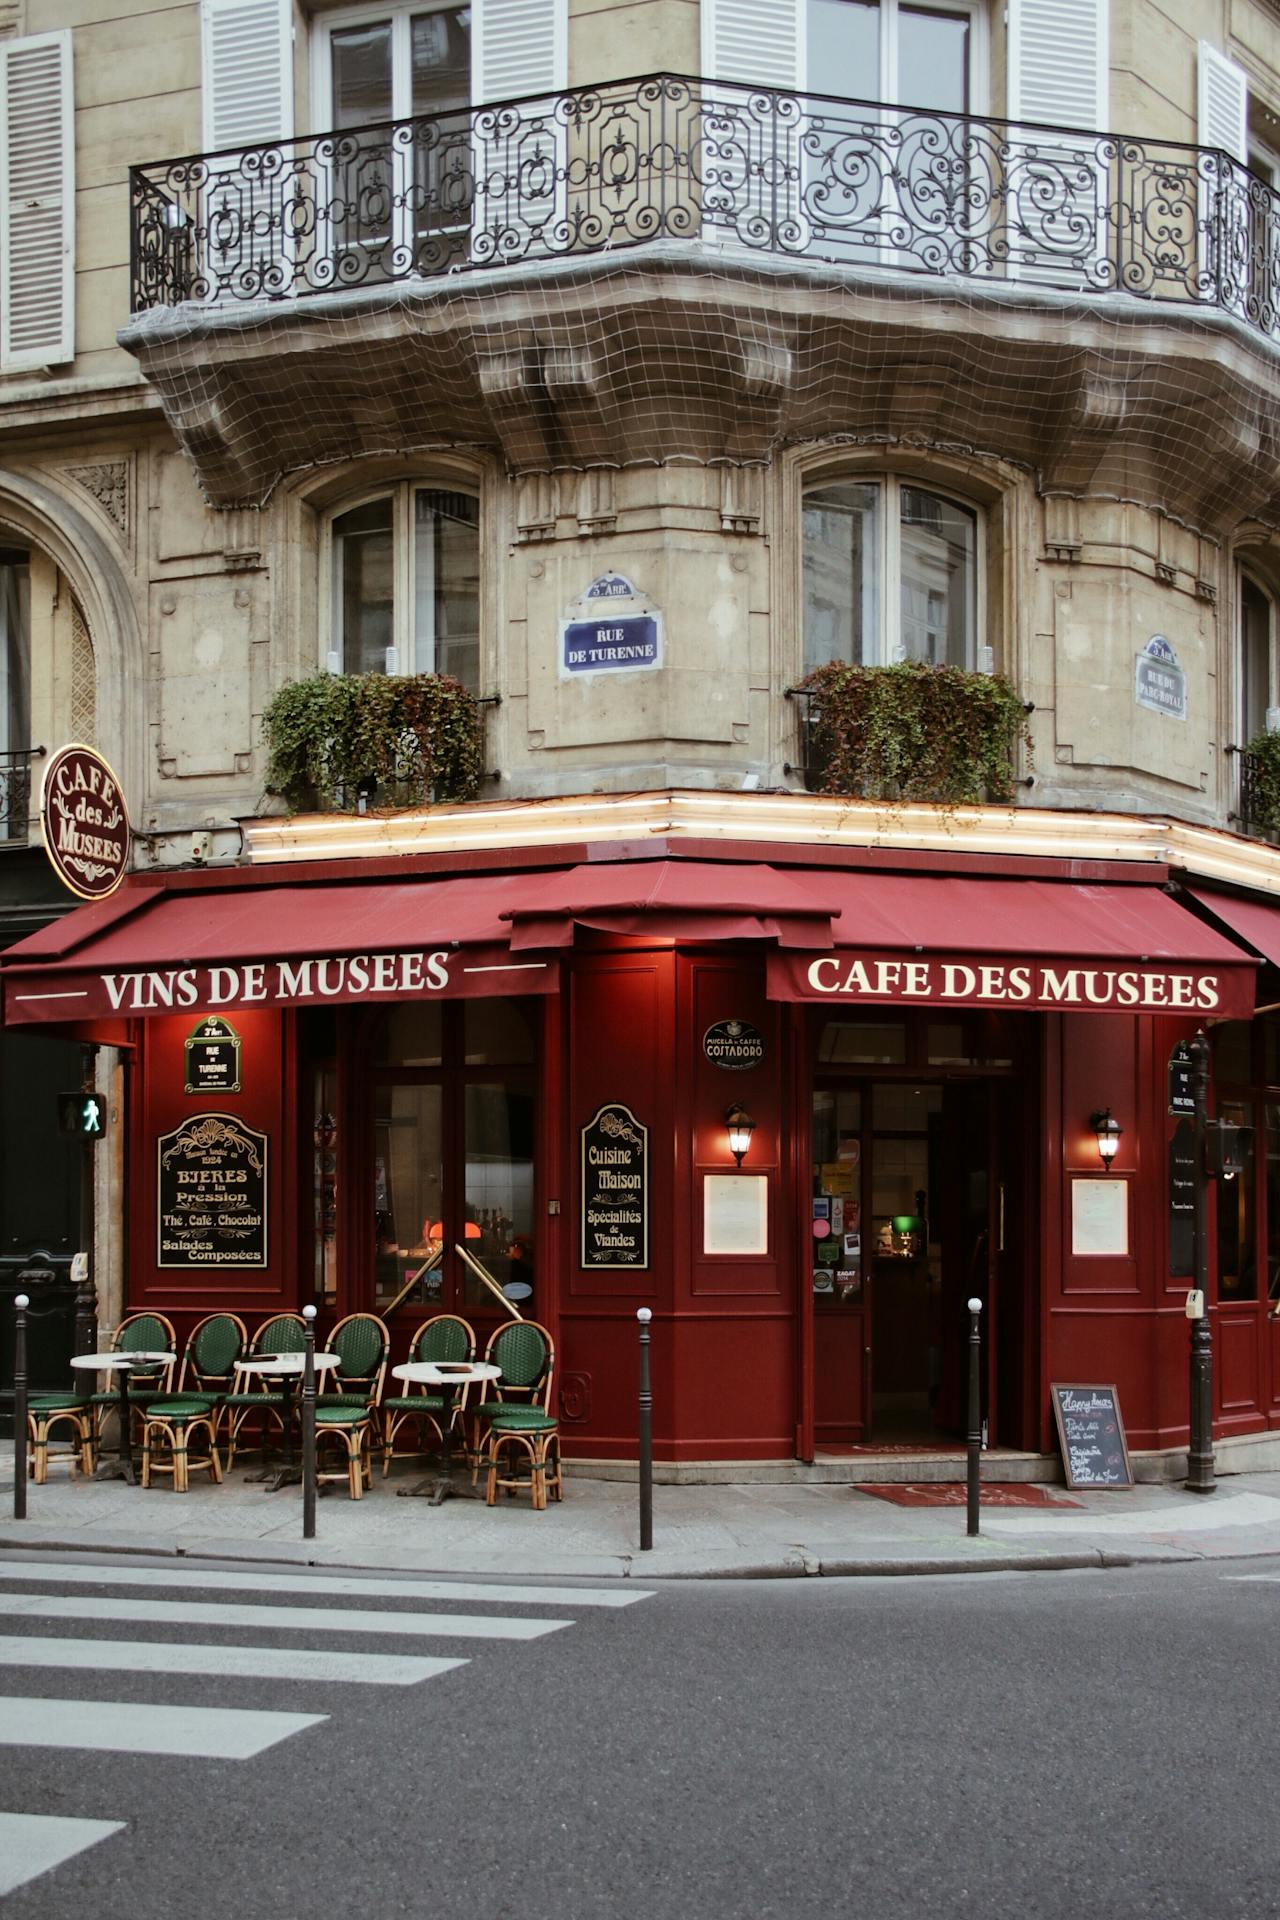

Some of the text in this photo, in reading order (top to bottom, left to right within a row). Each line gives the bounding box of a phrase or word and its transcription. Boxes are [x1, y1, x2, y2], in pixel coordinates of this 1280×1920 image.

[596, 629, 624, 642] RUE
[569, 644, 654, 663] DE TURENNE
[1148, 670, 1175, 690] RUE DU
[57, 763, 115, 808] CAFE
[75, 797, 103, 826] des
[101, 952, 449, 1009] VINS DE MUSEES
[807, 958, 1219, 1009] CAFE DES MUSEES
[206, 1046, 220, 1056] RUE
[707, 1045, 763, 1057] COSTADORO
[198, 1064, 228, 1074] TURENNE
[588, 1145, 632, 1165] Cuisine
[598, 1170, 642, 1189] Maison
[176, 1192, 247, 1202] Pression
[218, 1215, 262, 1226] Chocolat
[587, 1209, 642, 1226] Spécialités
[609, 1225, 619, 1234] de
[162, 1240, 213, 1250] Salades
[594, 1233, 636, 1247] Viandes
[188, 1250, 262, 1262] Composées
[1059, 1388, 1091, 1413] Happy
